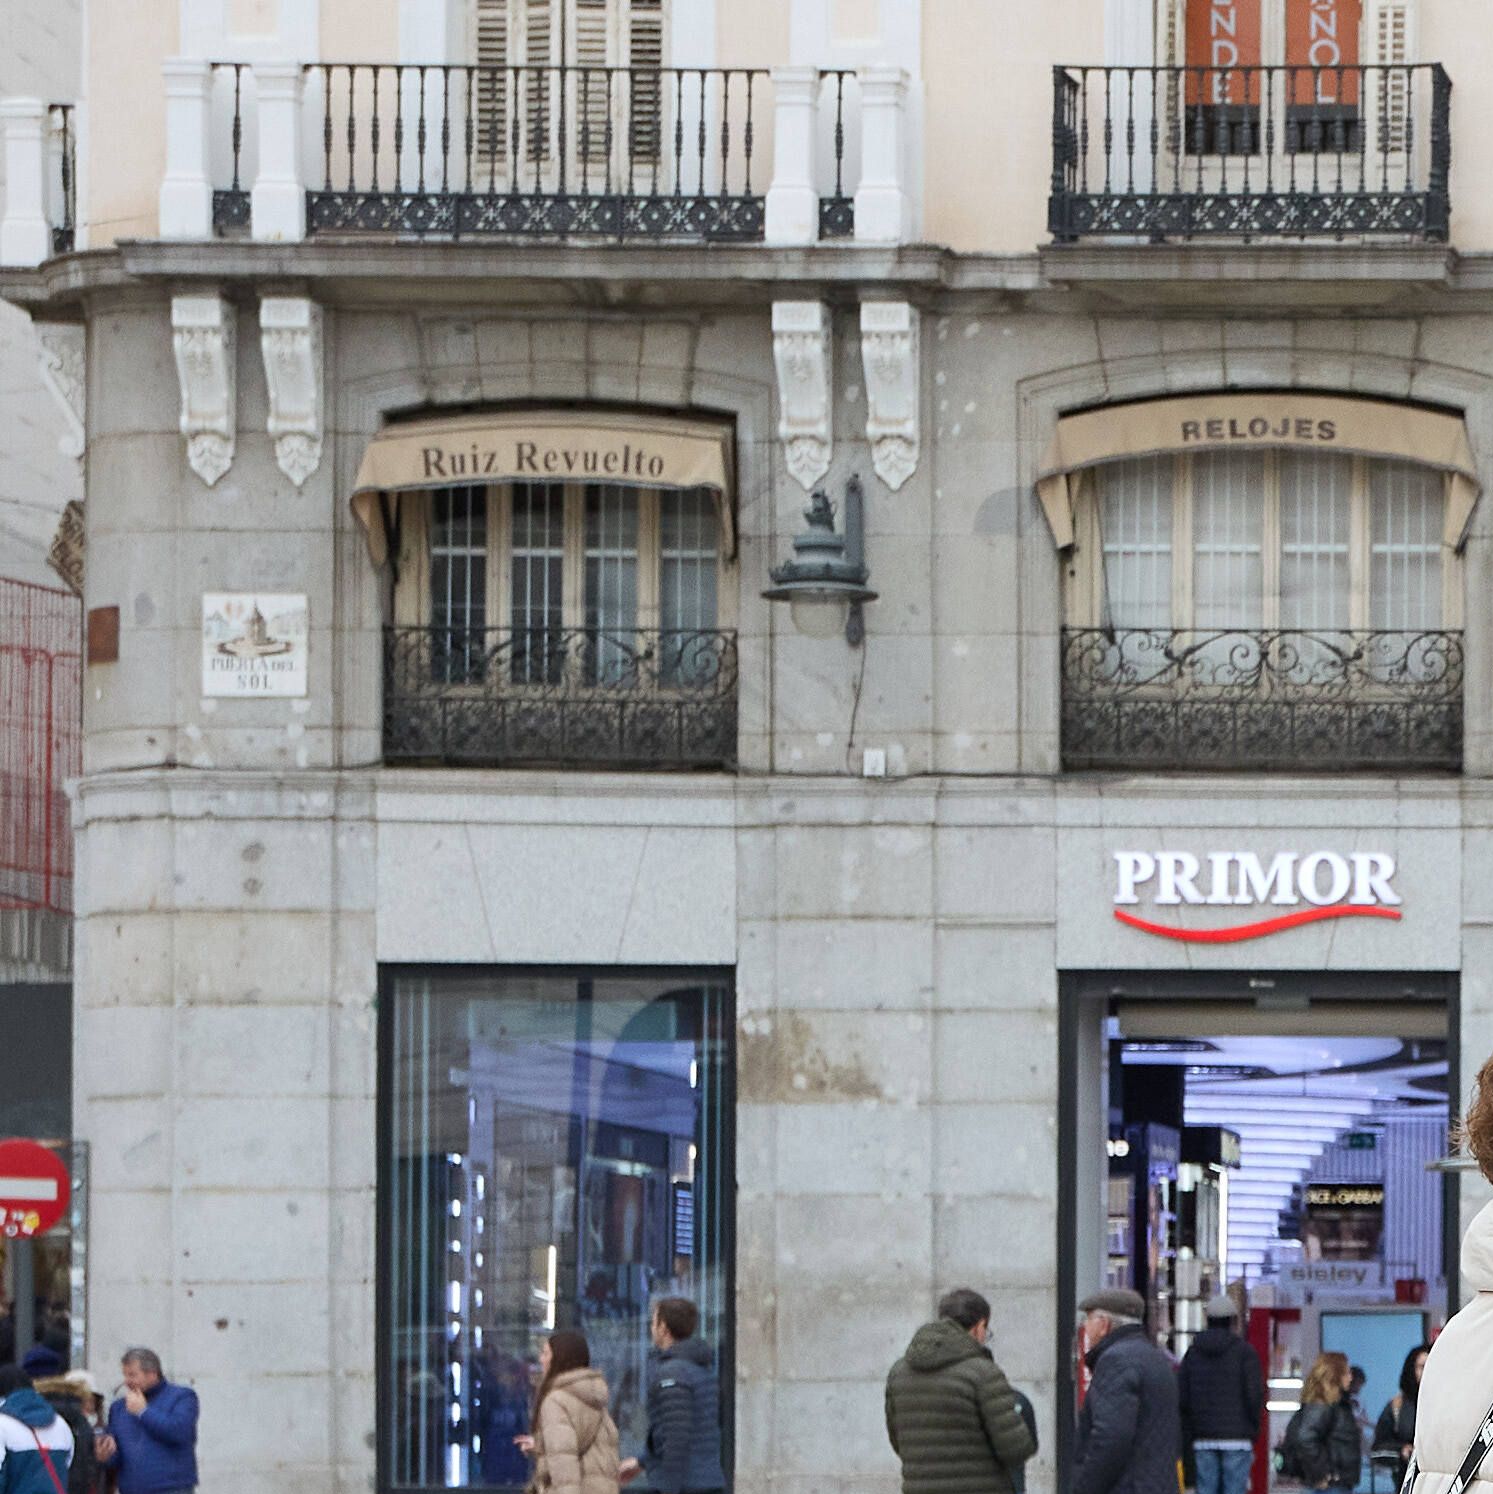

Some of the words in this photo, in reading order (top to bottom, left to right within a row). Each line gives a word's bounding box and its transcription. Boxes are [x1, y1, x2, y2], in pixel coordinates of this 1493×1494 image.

[1211, 0, 1239, 104] NDE
[1309, 0, 1341, 104] ÑOL
[1181, 417, 1337, 442] RELOJES
[422, 444, 498, 477] Ruiz
[515, 441, 665, 478] Revuelto
[211, 657, 269, 671] PUERTA
[237, 673, 273, 690] SOL
[1112, 850, 1402, 905] PRIMOR
